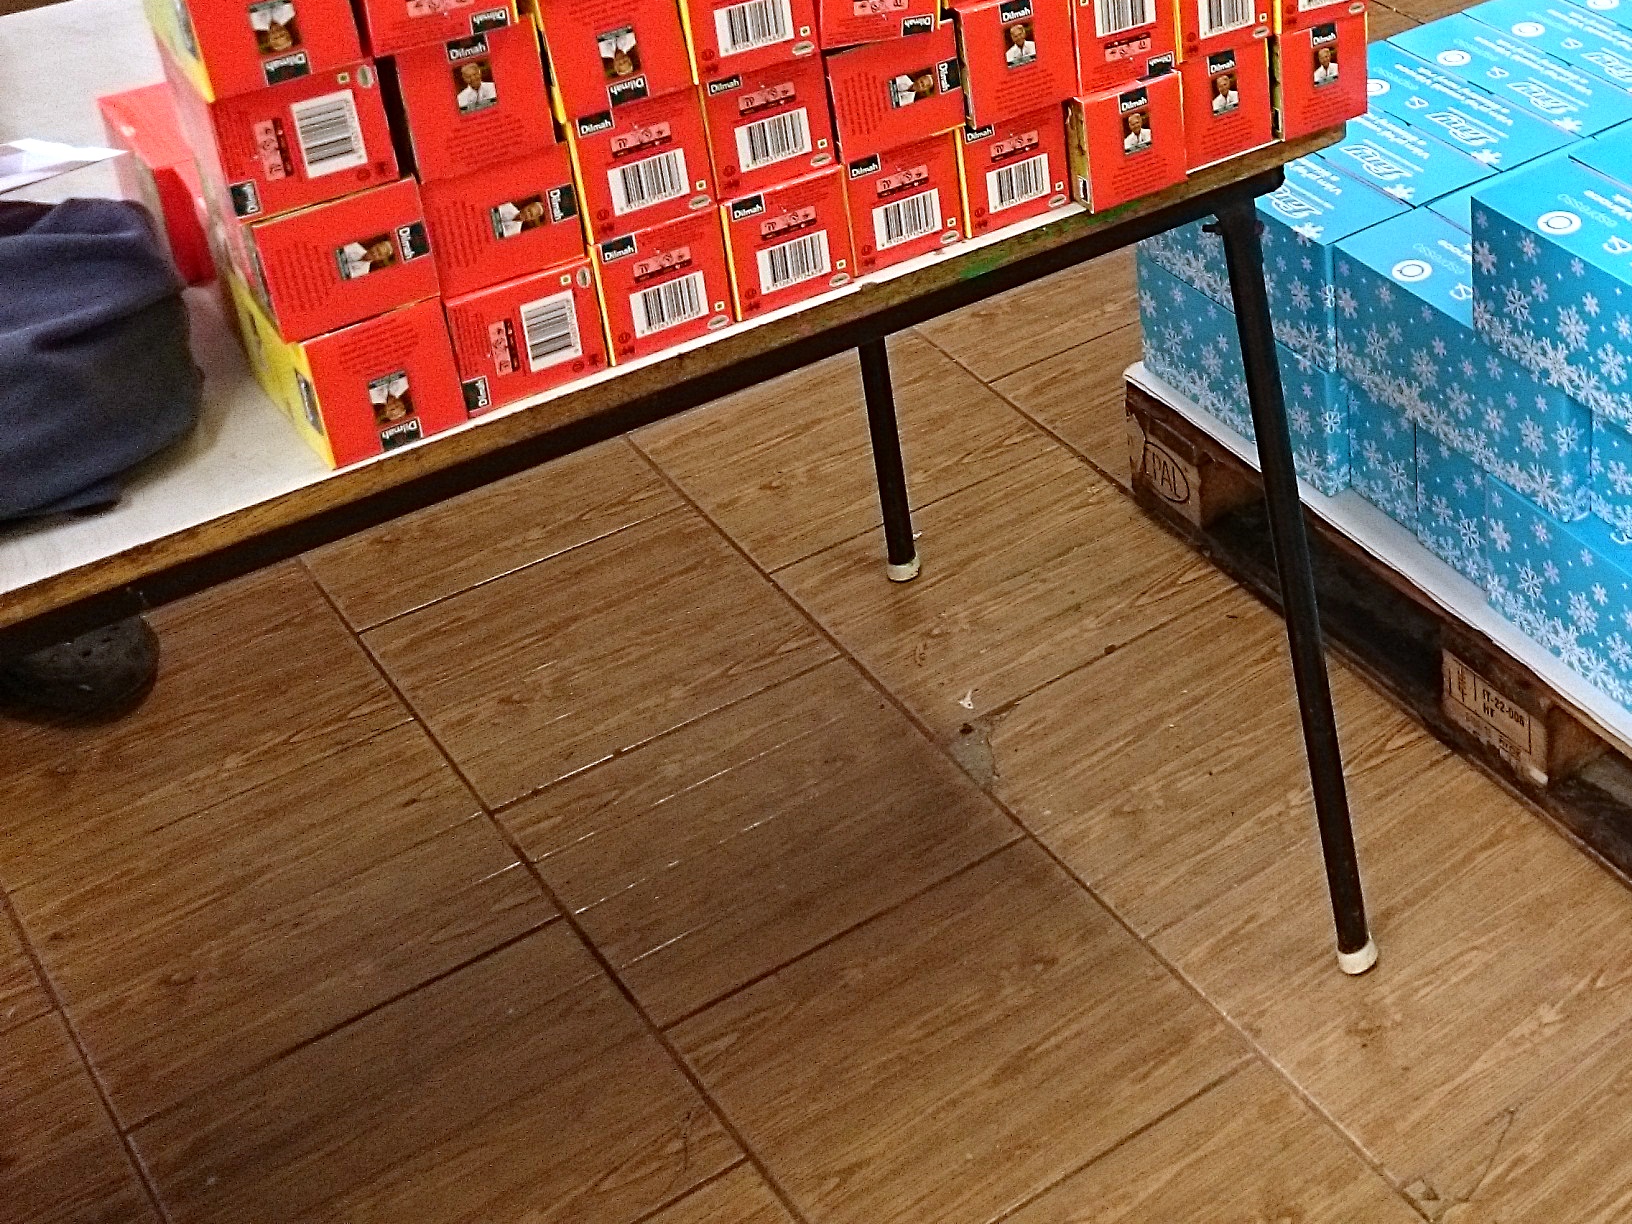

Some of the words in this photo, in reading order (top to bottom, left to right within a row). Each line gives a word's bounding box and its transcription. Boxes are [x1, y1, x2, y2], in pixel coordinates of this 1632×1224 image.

[473, 10, 506, 24] Dilmah
[1002, 5, 1032, 22] Dilmah
[1313, 32, 1337, 44] Dilmah
[448, 42, 486, 59] Dilmah
[267, 53, 304, 70] Dilmah
[1210, 60, 1236, 74] Dilmah
[938, 62, 948, 92] Dilmah
[611, 78, 645, 94] Dilmah
[709, 77, 740, 94] Dilmah
[1121, 97, 1148, 112] Dilmah
[580, 119, 612, 135] Dilmah
[966, 128, 993, 142] Dilmah
[851, 161, 879, 177] Dilmah
[550, 189, 563, 221] Dilmah
[732, 203, 763, 219] Dilmah
[399, 228, 415, 260] Dilmah
[603, 245, 634, 261] Dilmah
[380, 420, 418, 438] Dilmah
